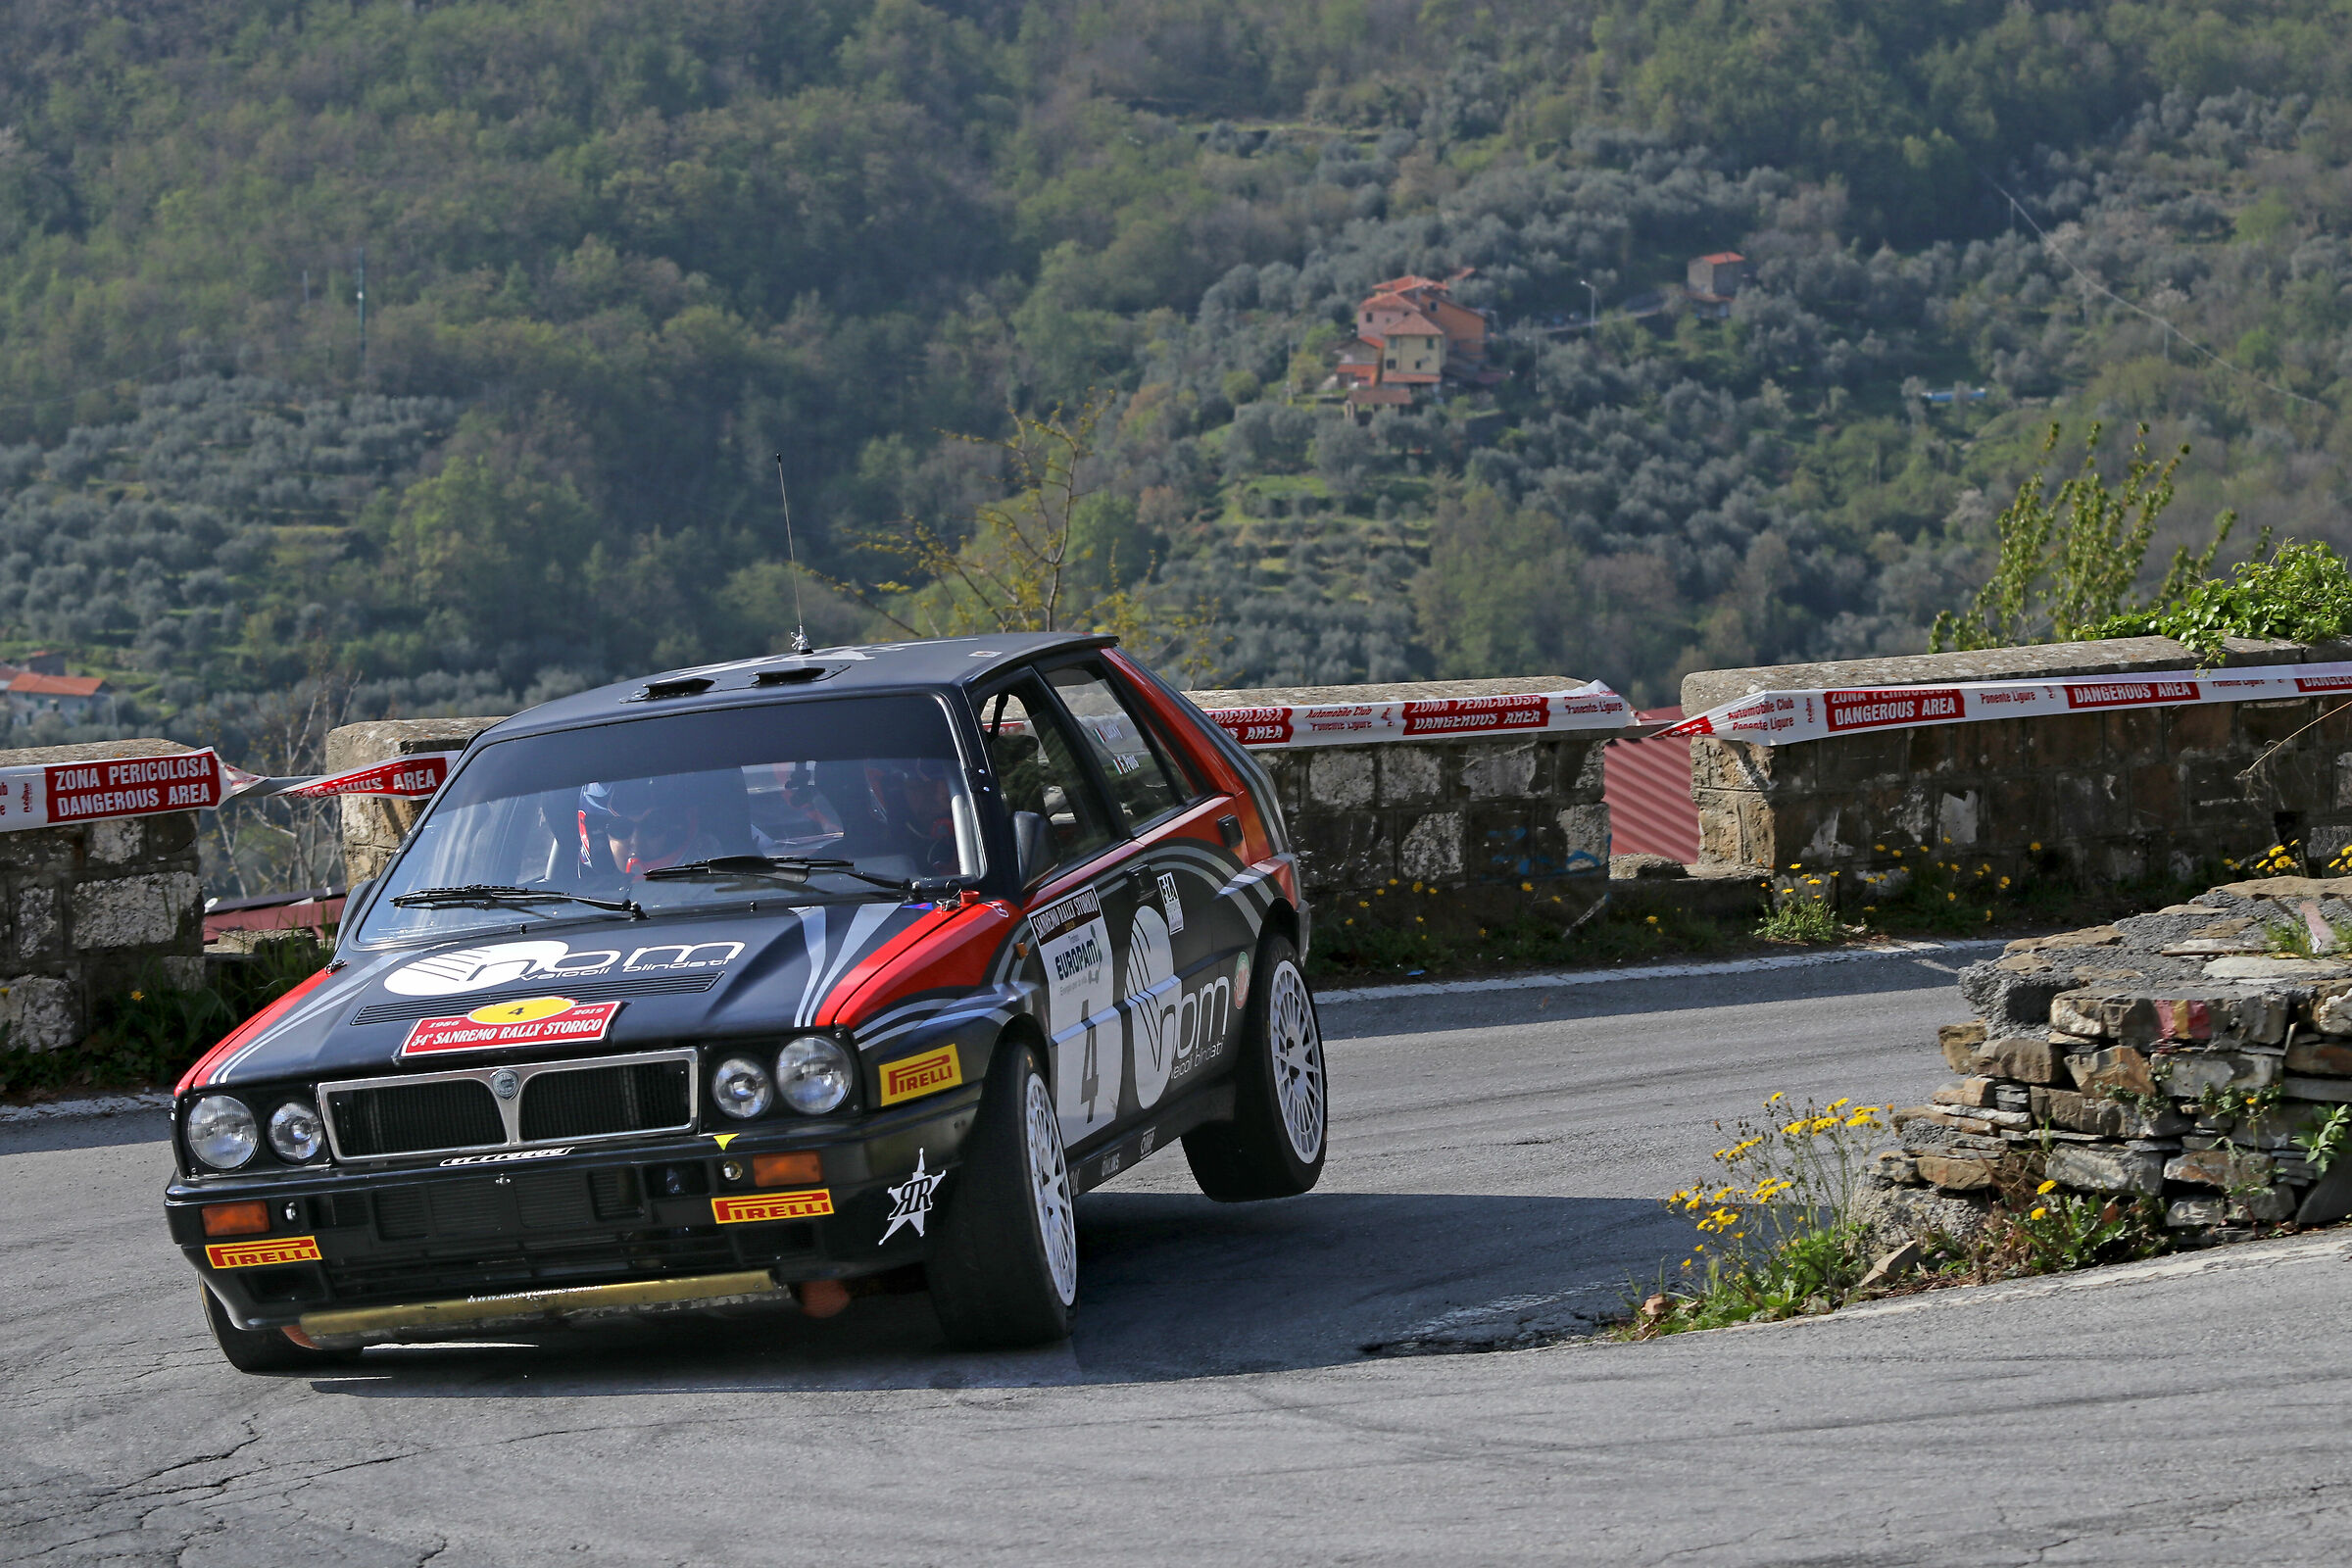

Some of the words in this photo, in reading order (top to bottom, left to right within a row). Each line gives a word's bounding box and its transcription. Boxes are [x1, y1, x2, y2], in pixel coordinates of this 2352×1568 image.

[2075, 683, 2153, 703] DANGEROUS
[2158, 682, 2192, 697] AREA
[1304, 707, 1352, 719] Automobile
[1353, 706, 1373, 716] Club
[1413, 713, 1498, 730] DANGEROUS
[1502, 710, 1541, 724] AREA
[1728, 700, 1775, 720] Automobile
[1776, 697, 1794, 710] Club
[1835, 701, 1915, 726] DANGEROUS
[1922, 698, 1956, 716] AREA
[1245, 725, 1284, 740] AREA
[1769, 716, 1794, 731] Ligure
[54, 767, 100, 791] ZONA
[108, 757, 211, 786] PERICOLOSA
[393, 768, 437, 791] AREA
[57, 787, 160, 817] DANGEROUS
[168, 783, 211, 806] AREA
[622, 959, 729, 973] blindati
[508, 1007, 524, 1016] 4
[571, 1007, 606, 1016] 2019
[427, 1019, 461, 1029] 1986
[432, 1027, 498, 1045] SANREMO
[498, 1022, 544, 1040] RALLY
[543, 1018, 604, 1036] STORICO
[1081, 999, 1100, 1124] 4
[889, 1054, 954, 1096] PIRELLI
[714, 1191, 830, 1221] PIRELLI
[208, 1239, 318, 1267] PIRELLI
